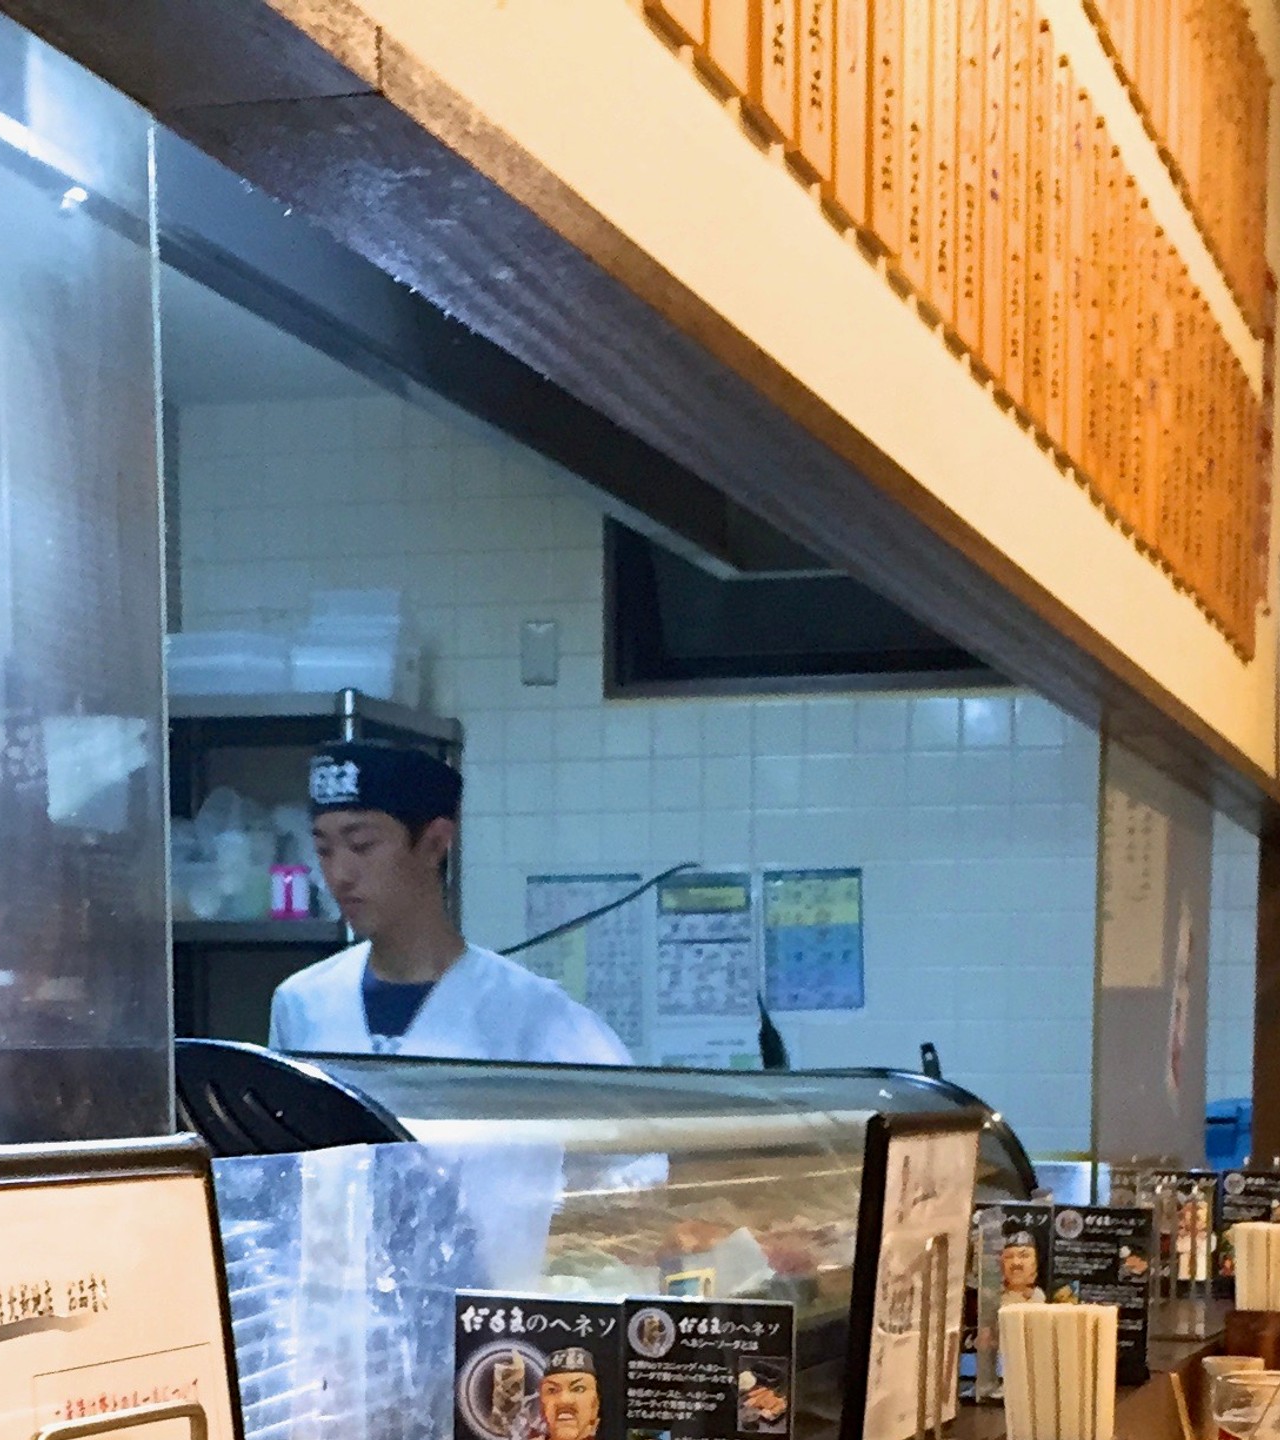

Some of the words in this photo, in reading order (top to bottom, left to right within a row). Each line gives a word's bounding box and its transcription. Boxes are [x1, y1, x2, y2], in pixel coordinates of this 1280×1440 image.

[460, 1305, 616, 1337] だるまのヘネソ
[678, 1316, 780, 1336] だるまのヘネソ
